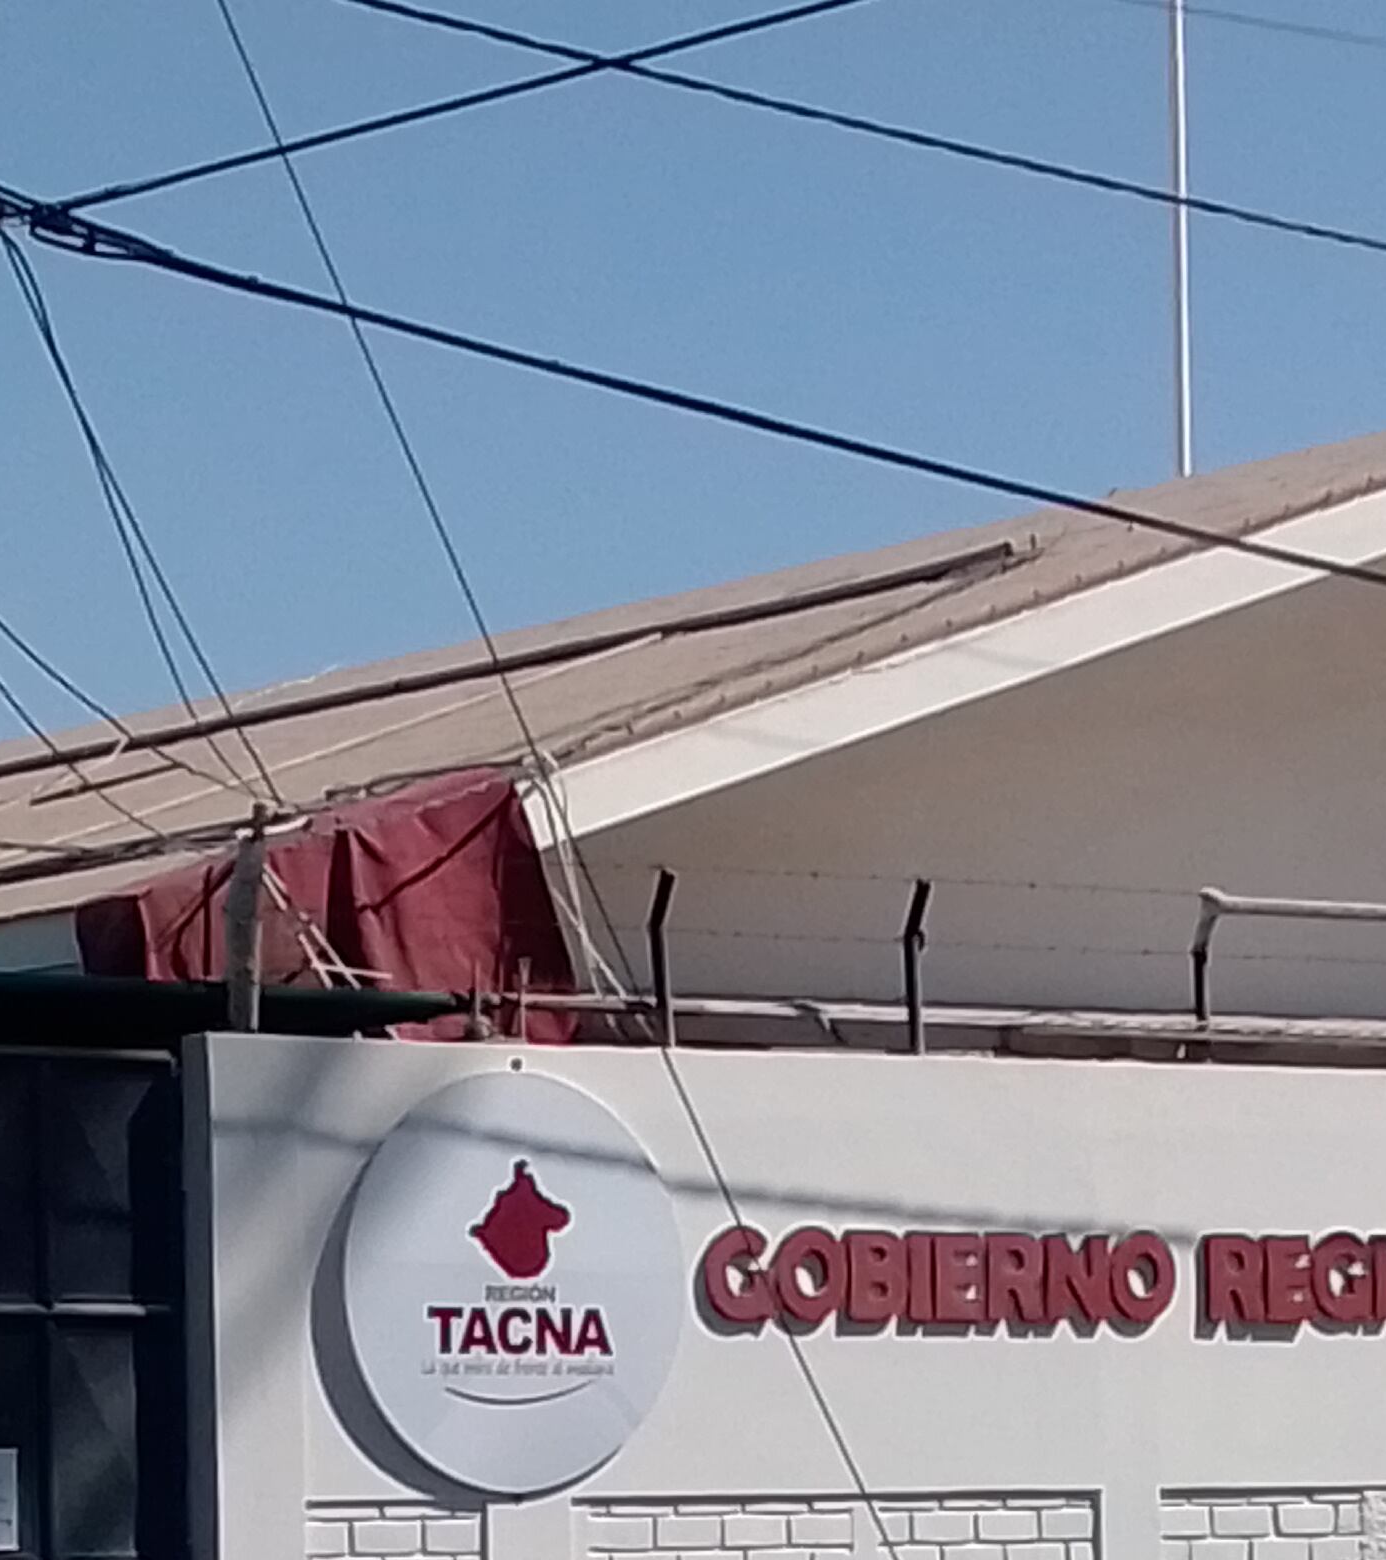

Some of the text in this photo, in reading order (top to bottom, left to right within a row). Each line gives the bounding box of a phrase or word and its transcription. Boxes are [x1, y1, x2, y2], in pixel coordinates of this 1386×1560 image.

[485, 1283, 556, 1303] REGIÓN
[695, 1226, 1176, 1335] GOBIERNO
[426, 1306, 614, 1355] TACNA
